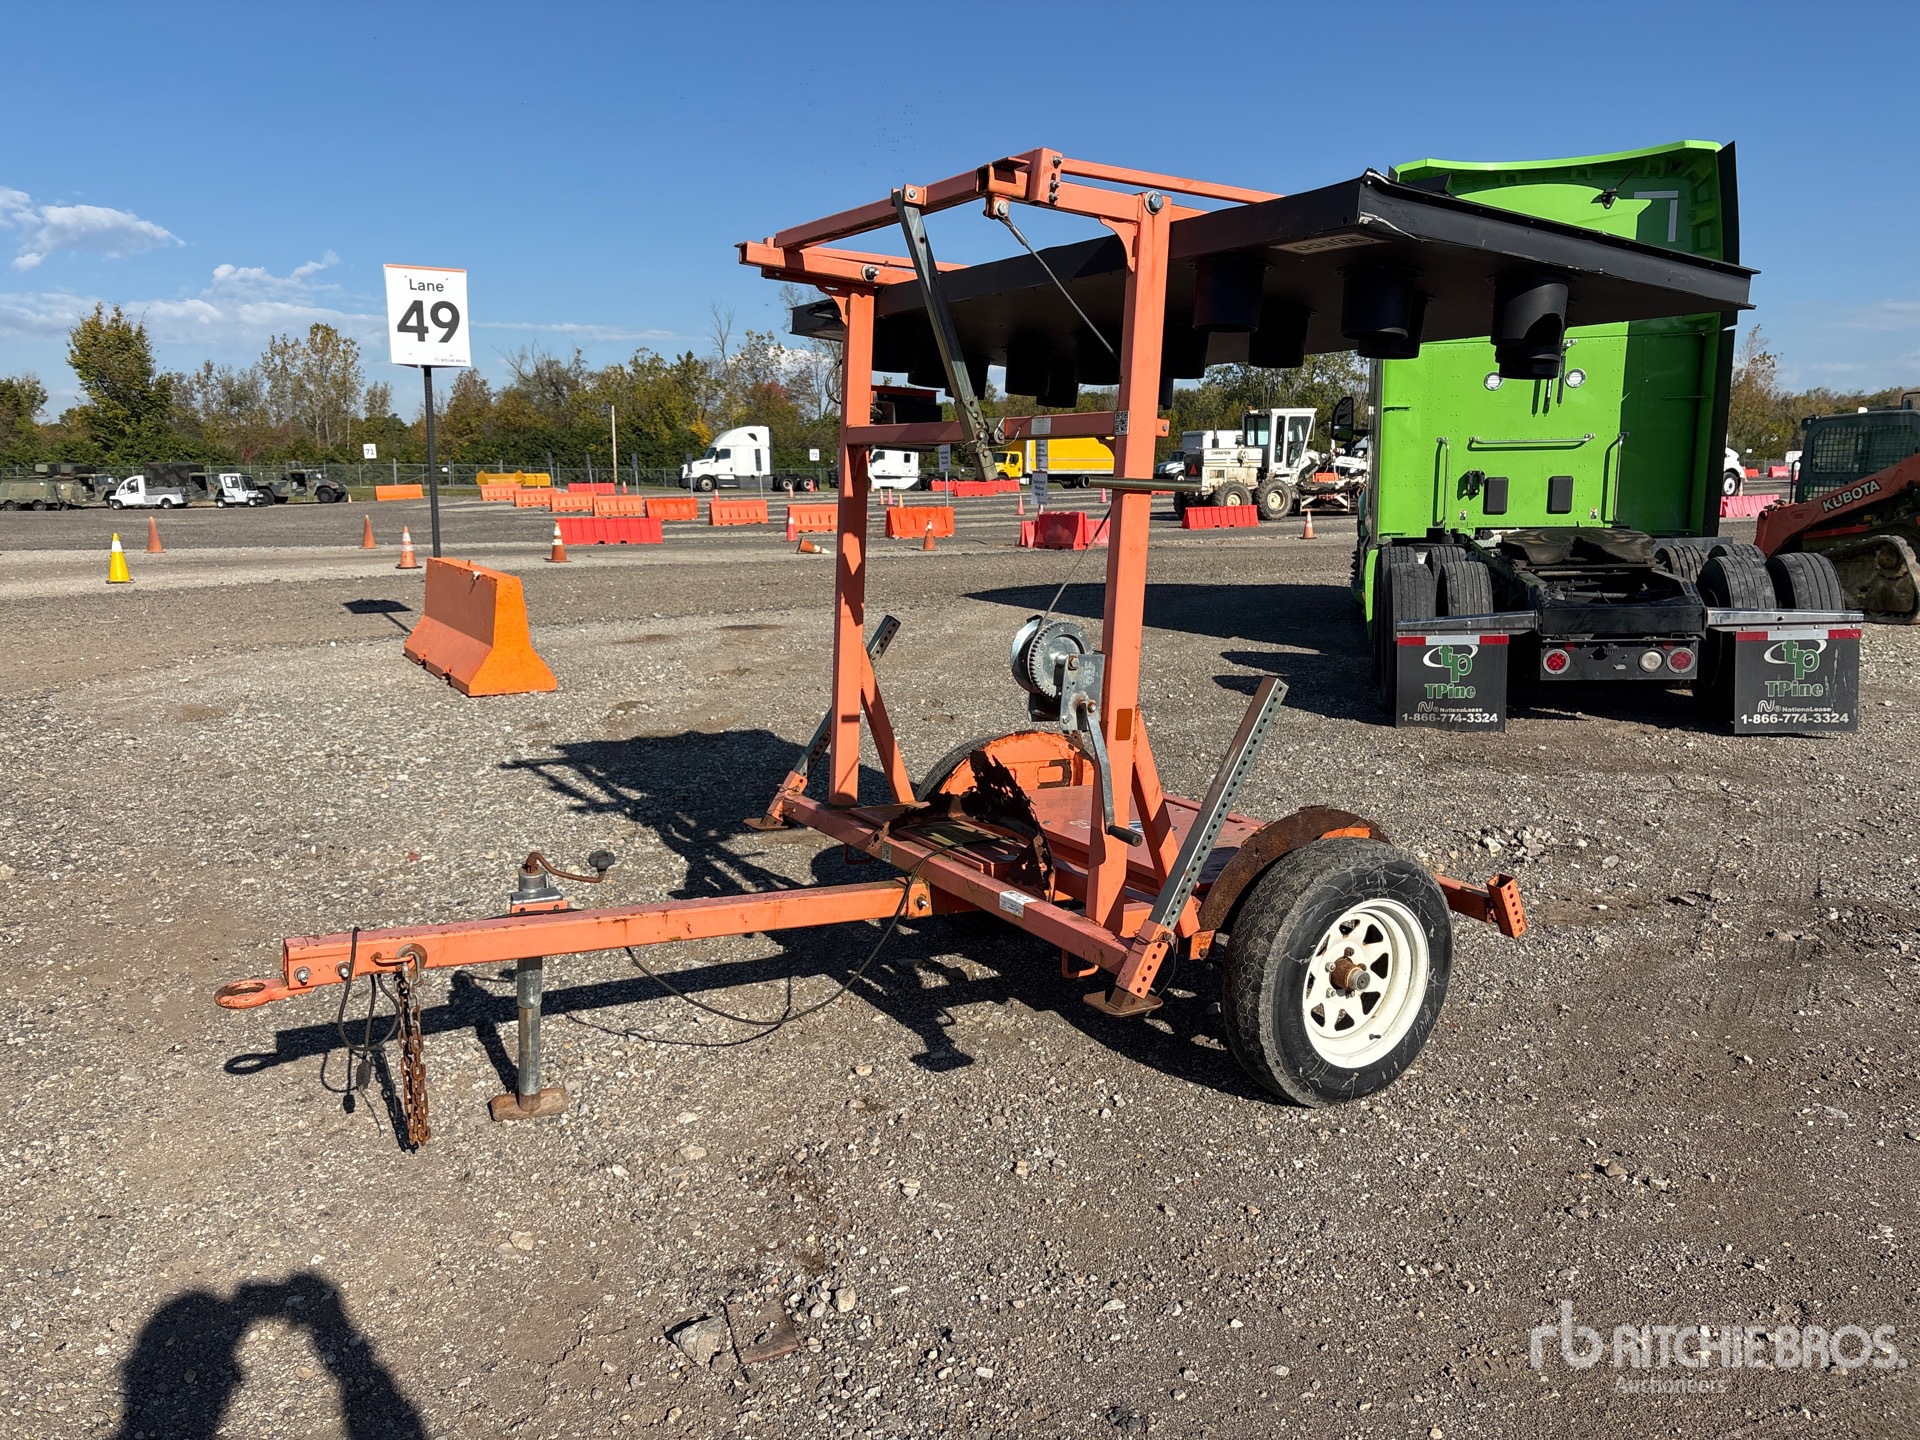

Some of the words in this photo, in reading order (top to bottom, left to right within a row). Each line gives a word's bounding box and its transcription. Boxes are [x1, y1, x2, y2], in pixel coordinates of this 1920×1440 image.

[409, 278, 444, 292] Lane
[397, 300, 460, 343] 49
[365, 448, 375, 456] 71
[1822, 480, 1881, 512] KUBOTA
[1424, 683, 1477, 699] TPine
[1764, 680, 1824, 698] TPine
[1401, 713, 1498, 723] 1-866-774-3324
[1740, 713, 1850, 724] 1-866-774-3324
